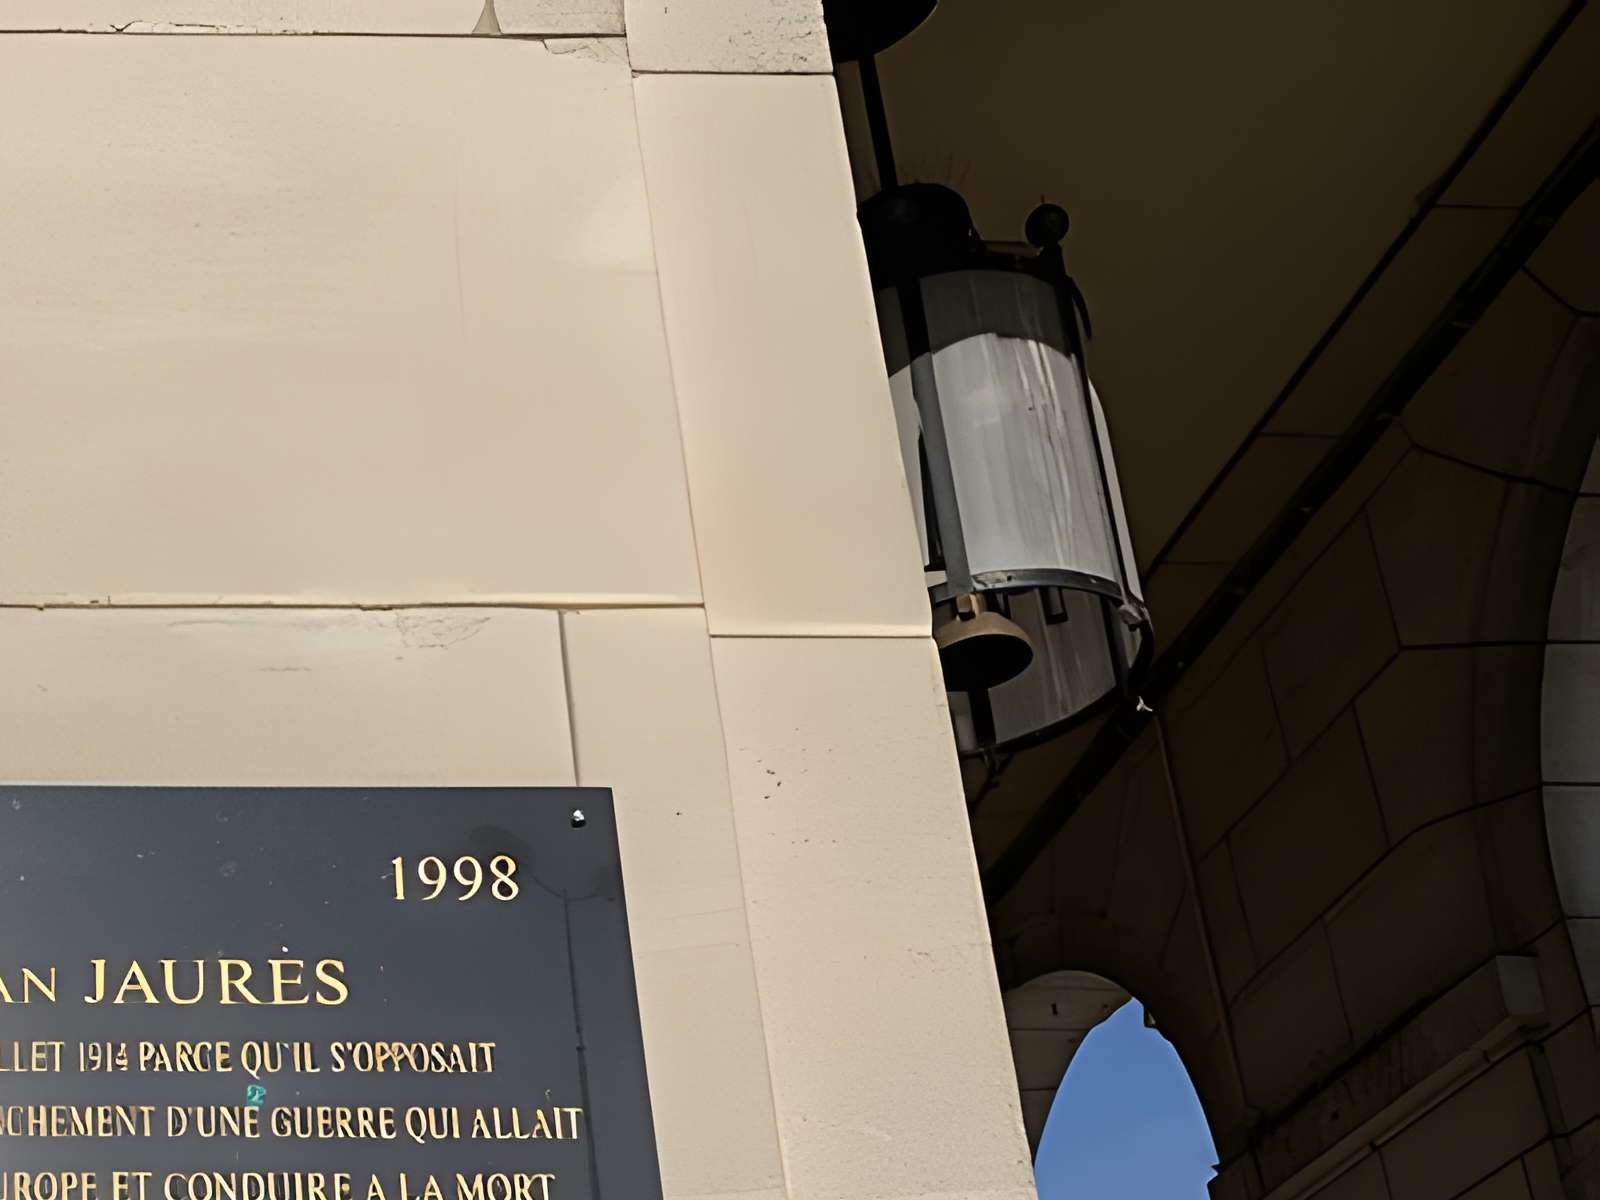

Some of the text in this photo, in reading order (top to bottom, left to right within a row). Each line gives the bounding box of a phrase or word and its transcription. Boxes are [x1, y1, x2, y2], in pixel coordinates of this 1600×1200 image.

[391, 855, 520, 902] 1998
[78, 1041, 129, 1073] 1914
[138, 1040, 233, 1073] PARCE
[240, 1040, 321, 1081] QU'IL
[330, 1041, 497, 1074] S'OPPOSAIT
[166, 1105, 261, 1139] D'UNE
[271, 1106, 397, 1140] GUERRE
[404, 1106, 461, 1145] QUI
[470, 1106, 583, 1141] ALLAIT
